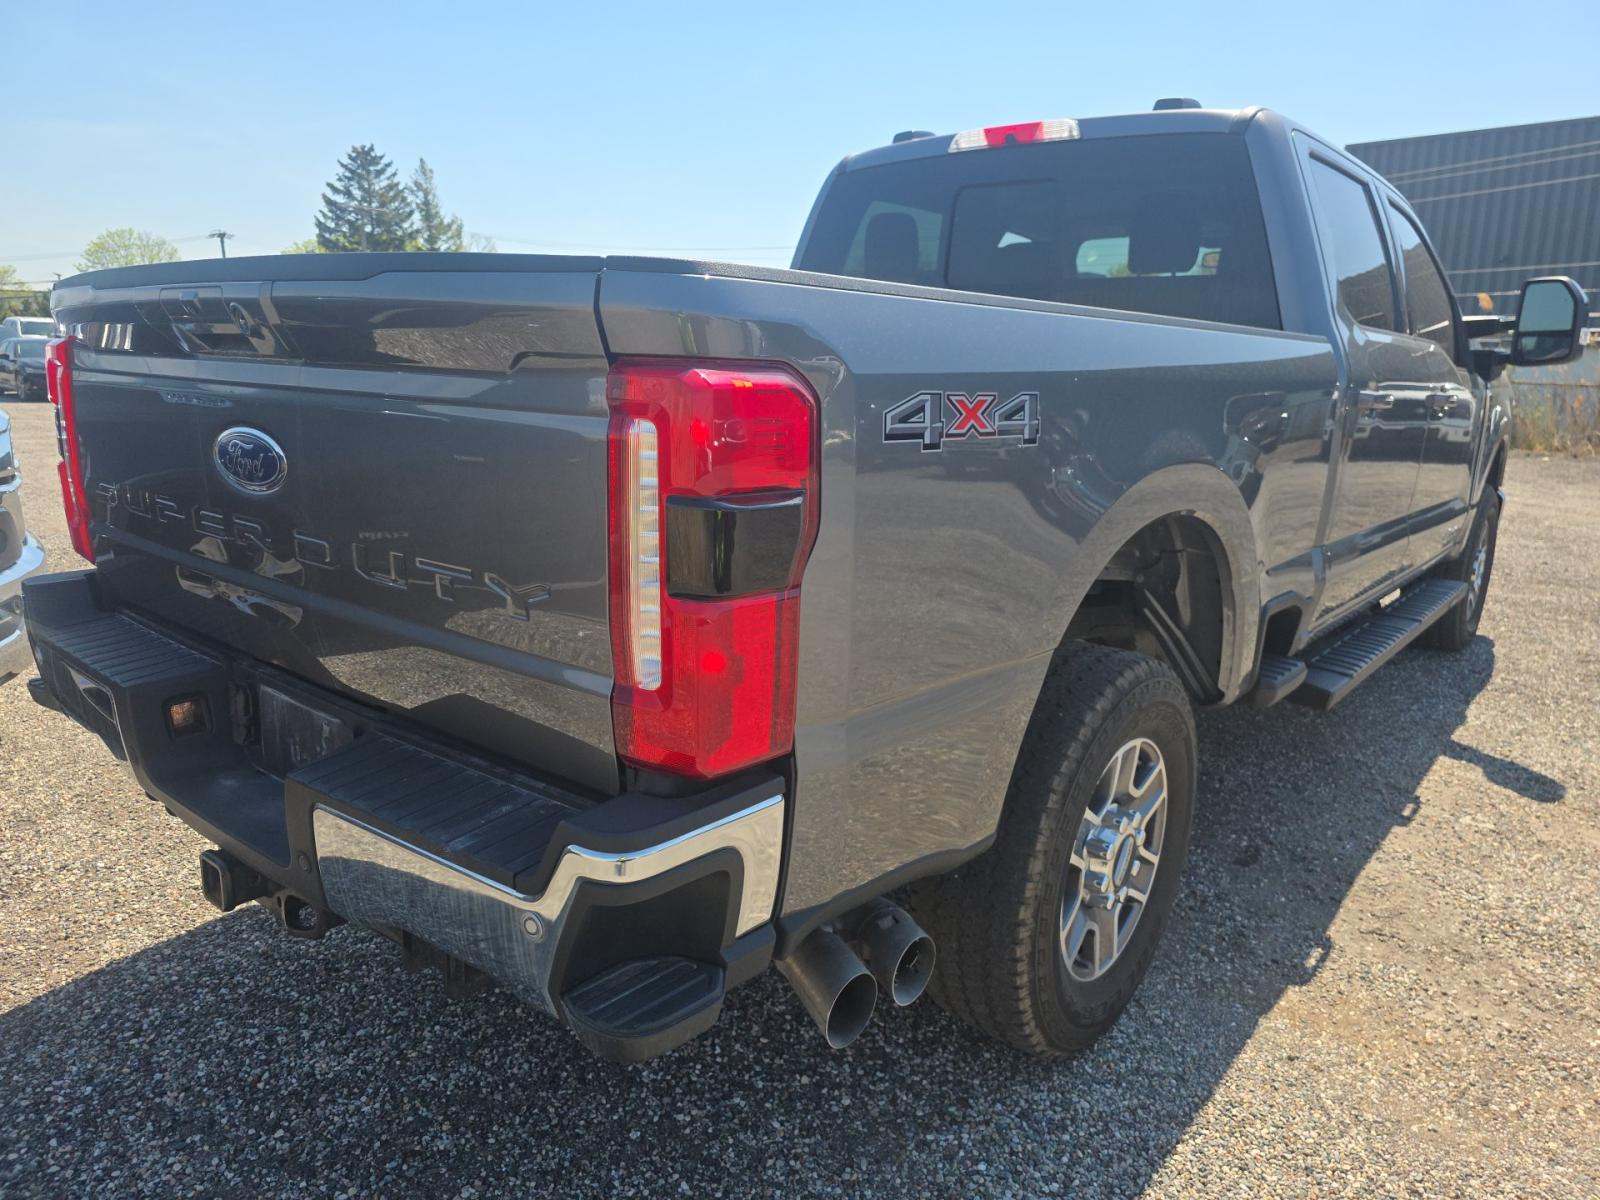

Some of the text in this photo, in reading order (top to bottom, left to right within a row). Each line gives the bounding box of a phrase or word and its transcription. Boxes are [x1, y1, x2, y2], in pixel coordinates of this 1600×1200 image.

[226, 439, 267, 478] Ford
[96, 481, 552, 621] SUPER DUTY
